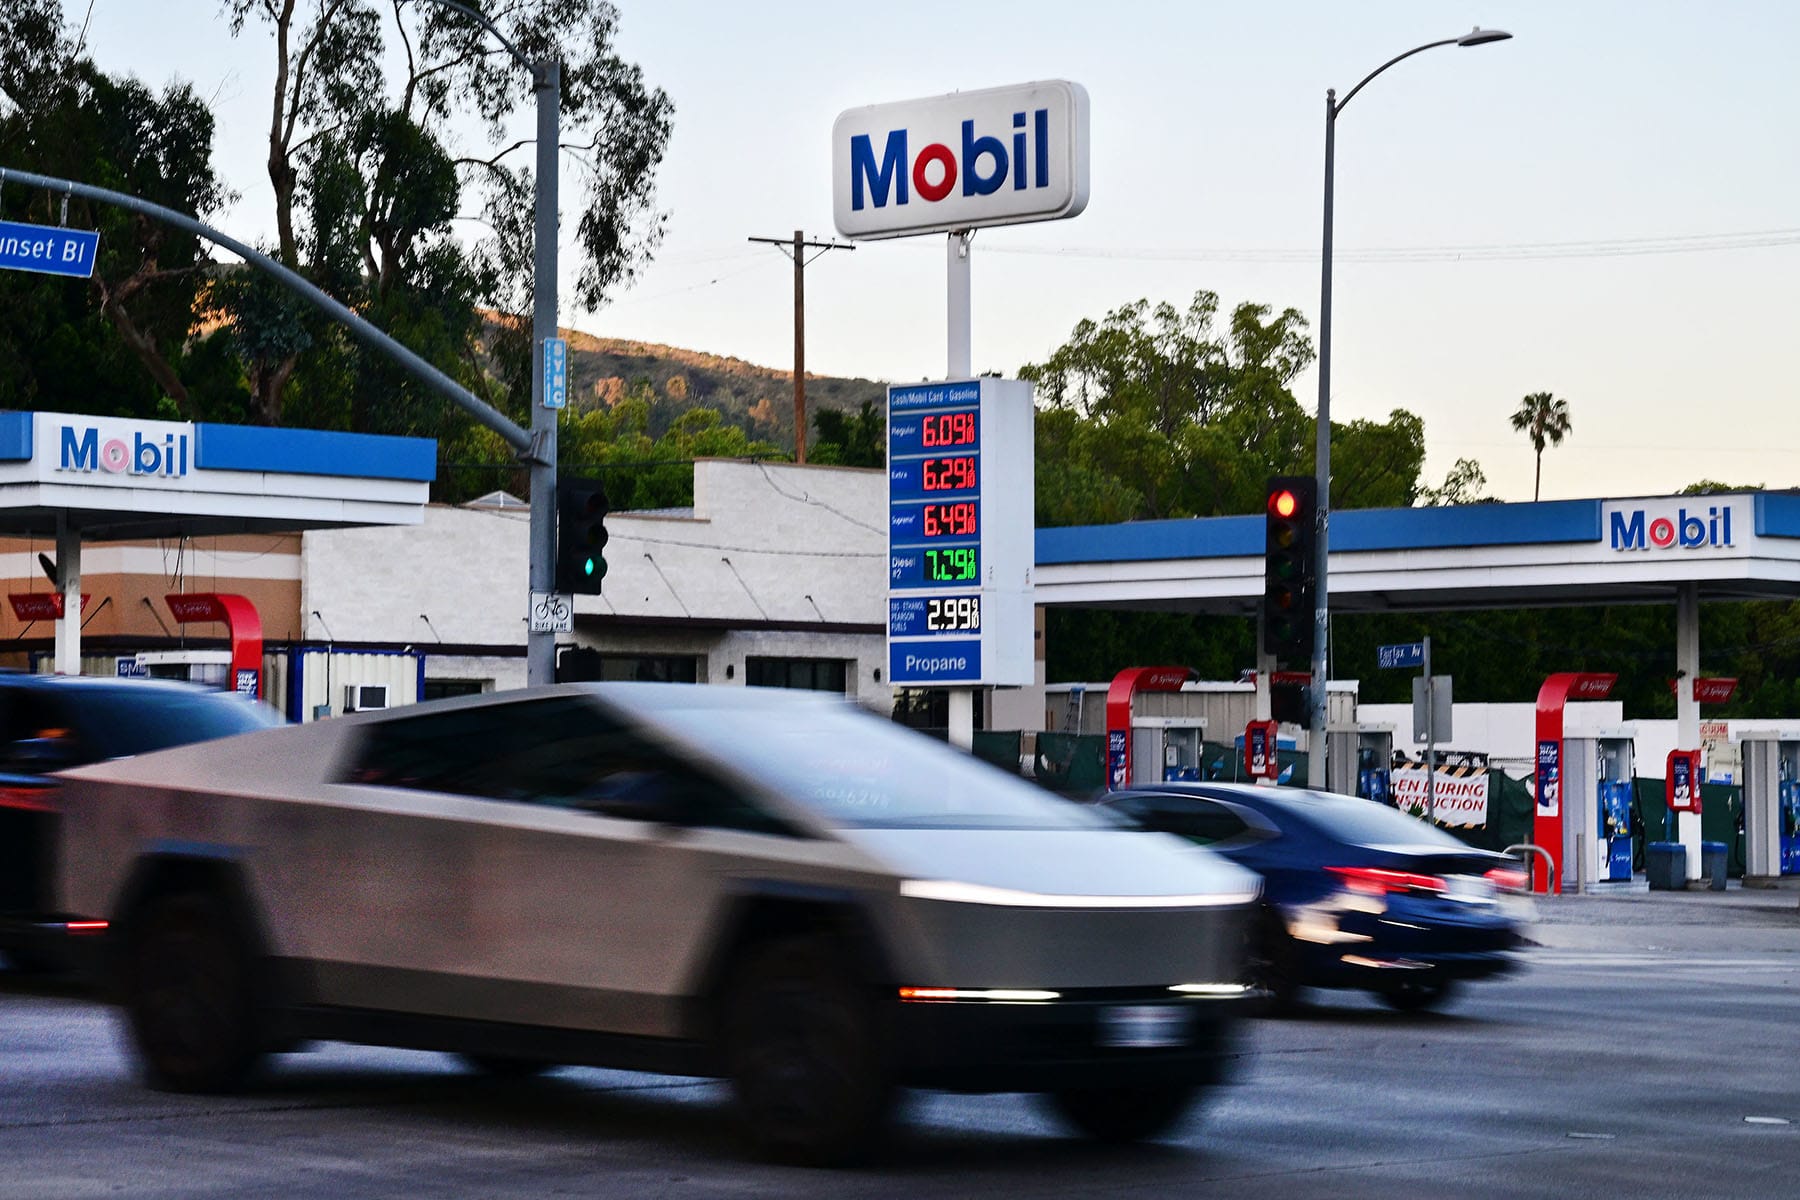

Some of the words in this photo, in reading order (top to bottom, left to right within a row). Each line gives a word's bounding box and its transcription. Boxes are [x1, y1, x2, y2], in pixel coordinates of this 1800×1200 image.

[851, 108, 1048, 211] Mobil
[62, 239, 85, 263] Bl
[928, 390, 943, 404] Card
[949, 389, 978, 402] Gasoline
[60, 426, 188, 477] Mobil
[1610, 506, 1733, 549] Mobil
[891, 557, 915, 568] Diesel
[905, 655, 967, 675] Propane
